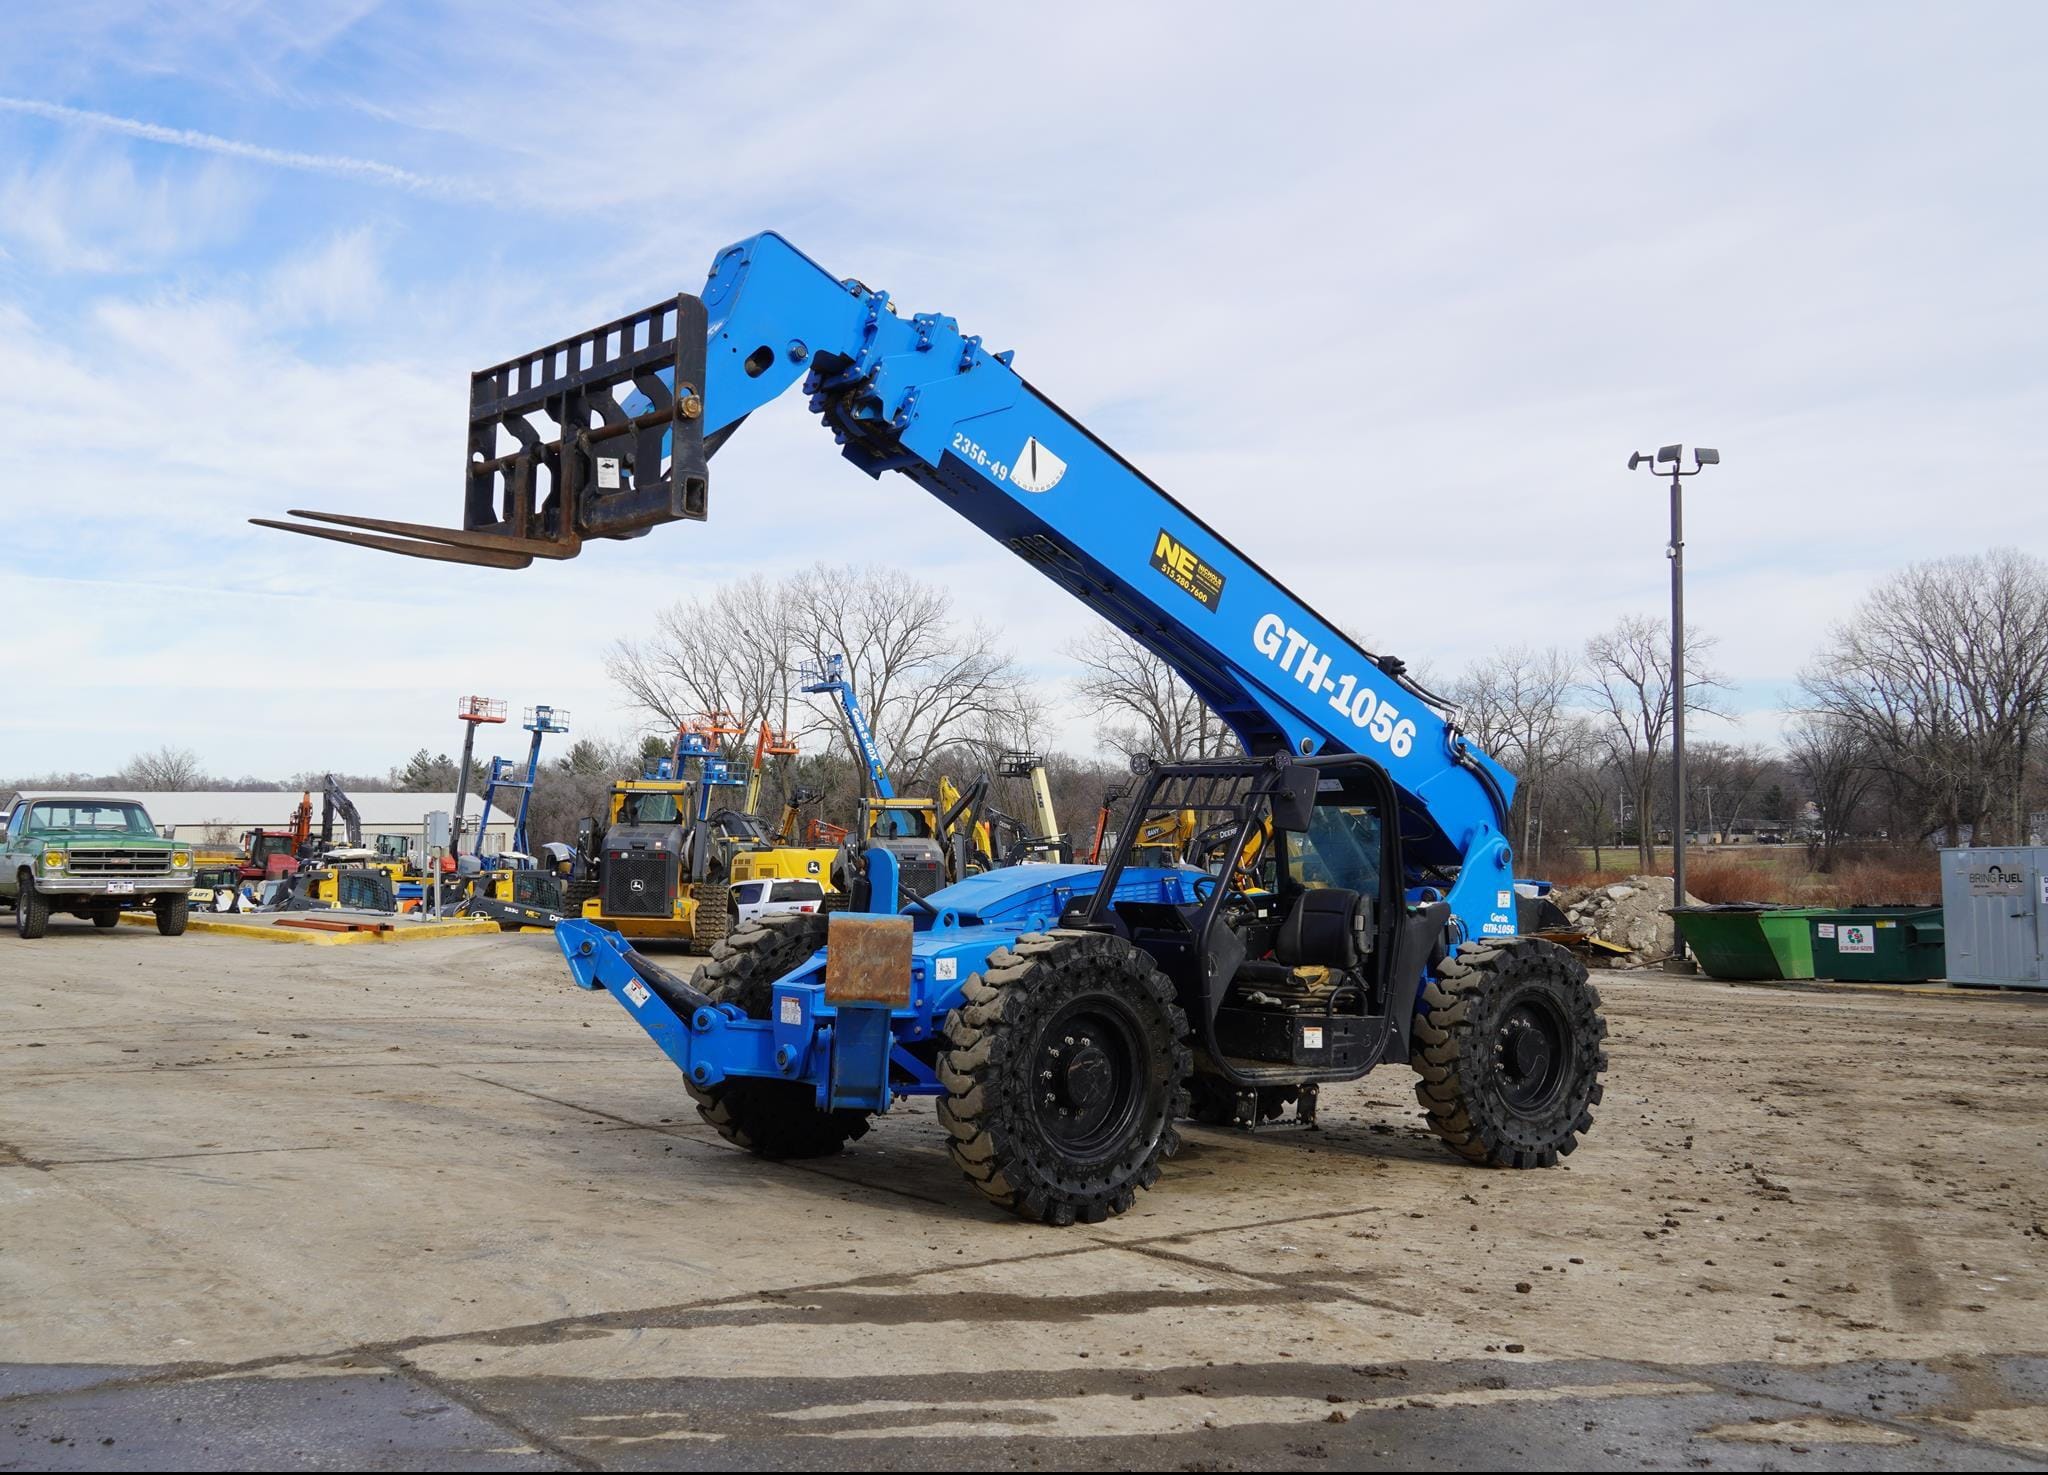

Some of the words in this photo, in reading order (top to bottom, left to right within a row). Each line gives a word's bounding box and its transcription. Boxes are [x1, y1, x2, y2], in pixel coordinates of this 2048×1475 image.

[952, 431, 1008, 481] 2356-49
[1156, 532, 1198, 581] NE
[1161, 563, 1208, 603] 515.280.7600
[1253, 613, 1417, 758] GTH-1056
[1969, 873, 1997, 883] BRING
[1998, 873, 2023, 883] FUEL
[1482, 923, 1516, 934] GTH-1056
[1490, 912, 1509, 923] Genie
